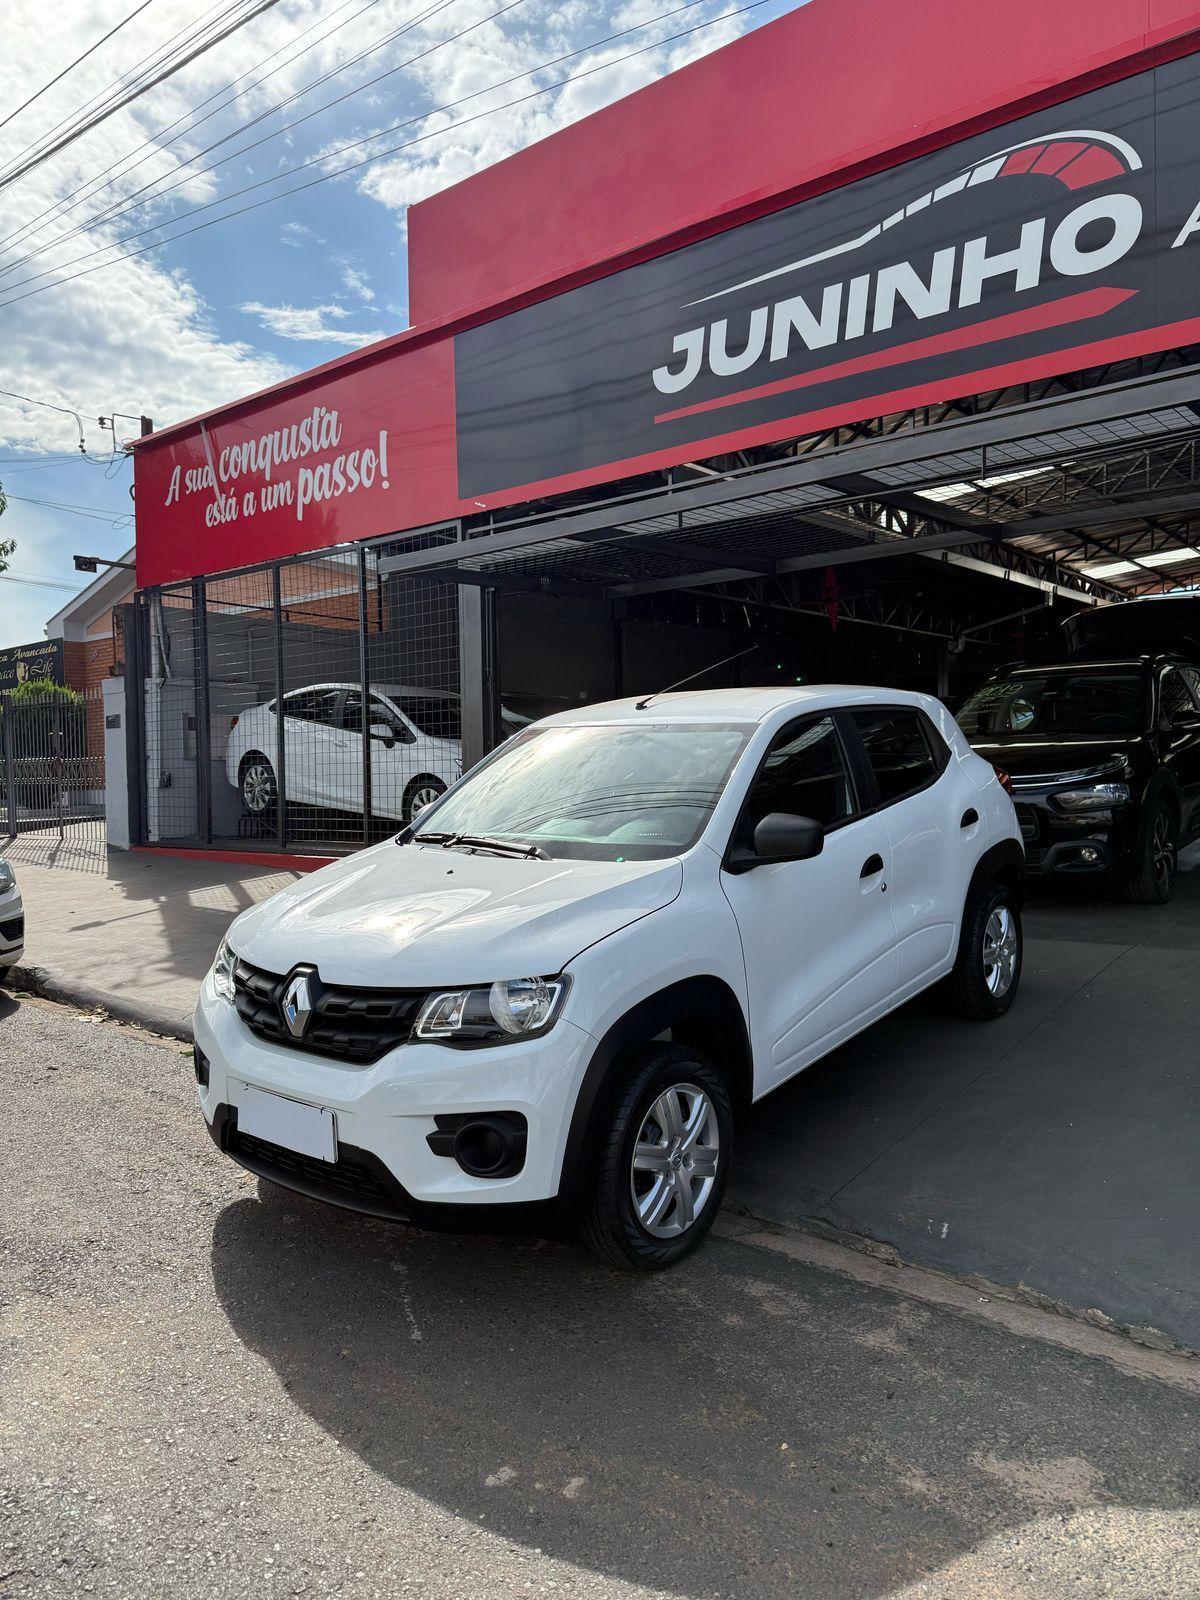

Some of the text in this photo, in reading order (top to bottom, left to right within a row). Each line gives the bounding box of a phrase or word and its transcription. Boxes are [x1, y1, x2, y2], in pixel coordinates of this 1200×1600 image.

[651, 193, 1143, 394] JUNINHO
[164, 406, 343, 506] A sua conquista
[205, 430, 390, 528] está a um passo!
